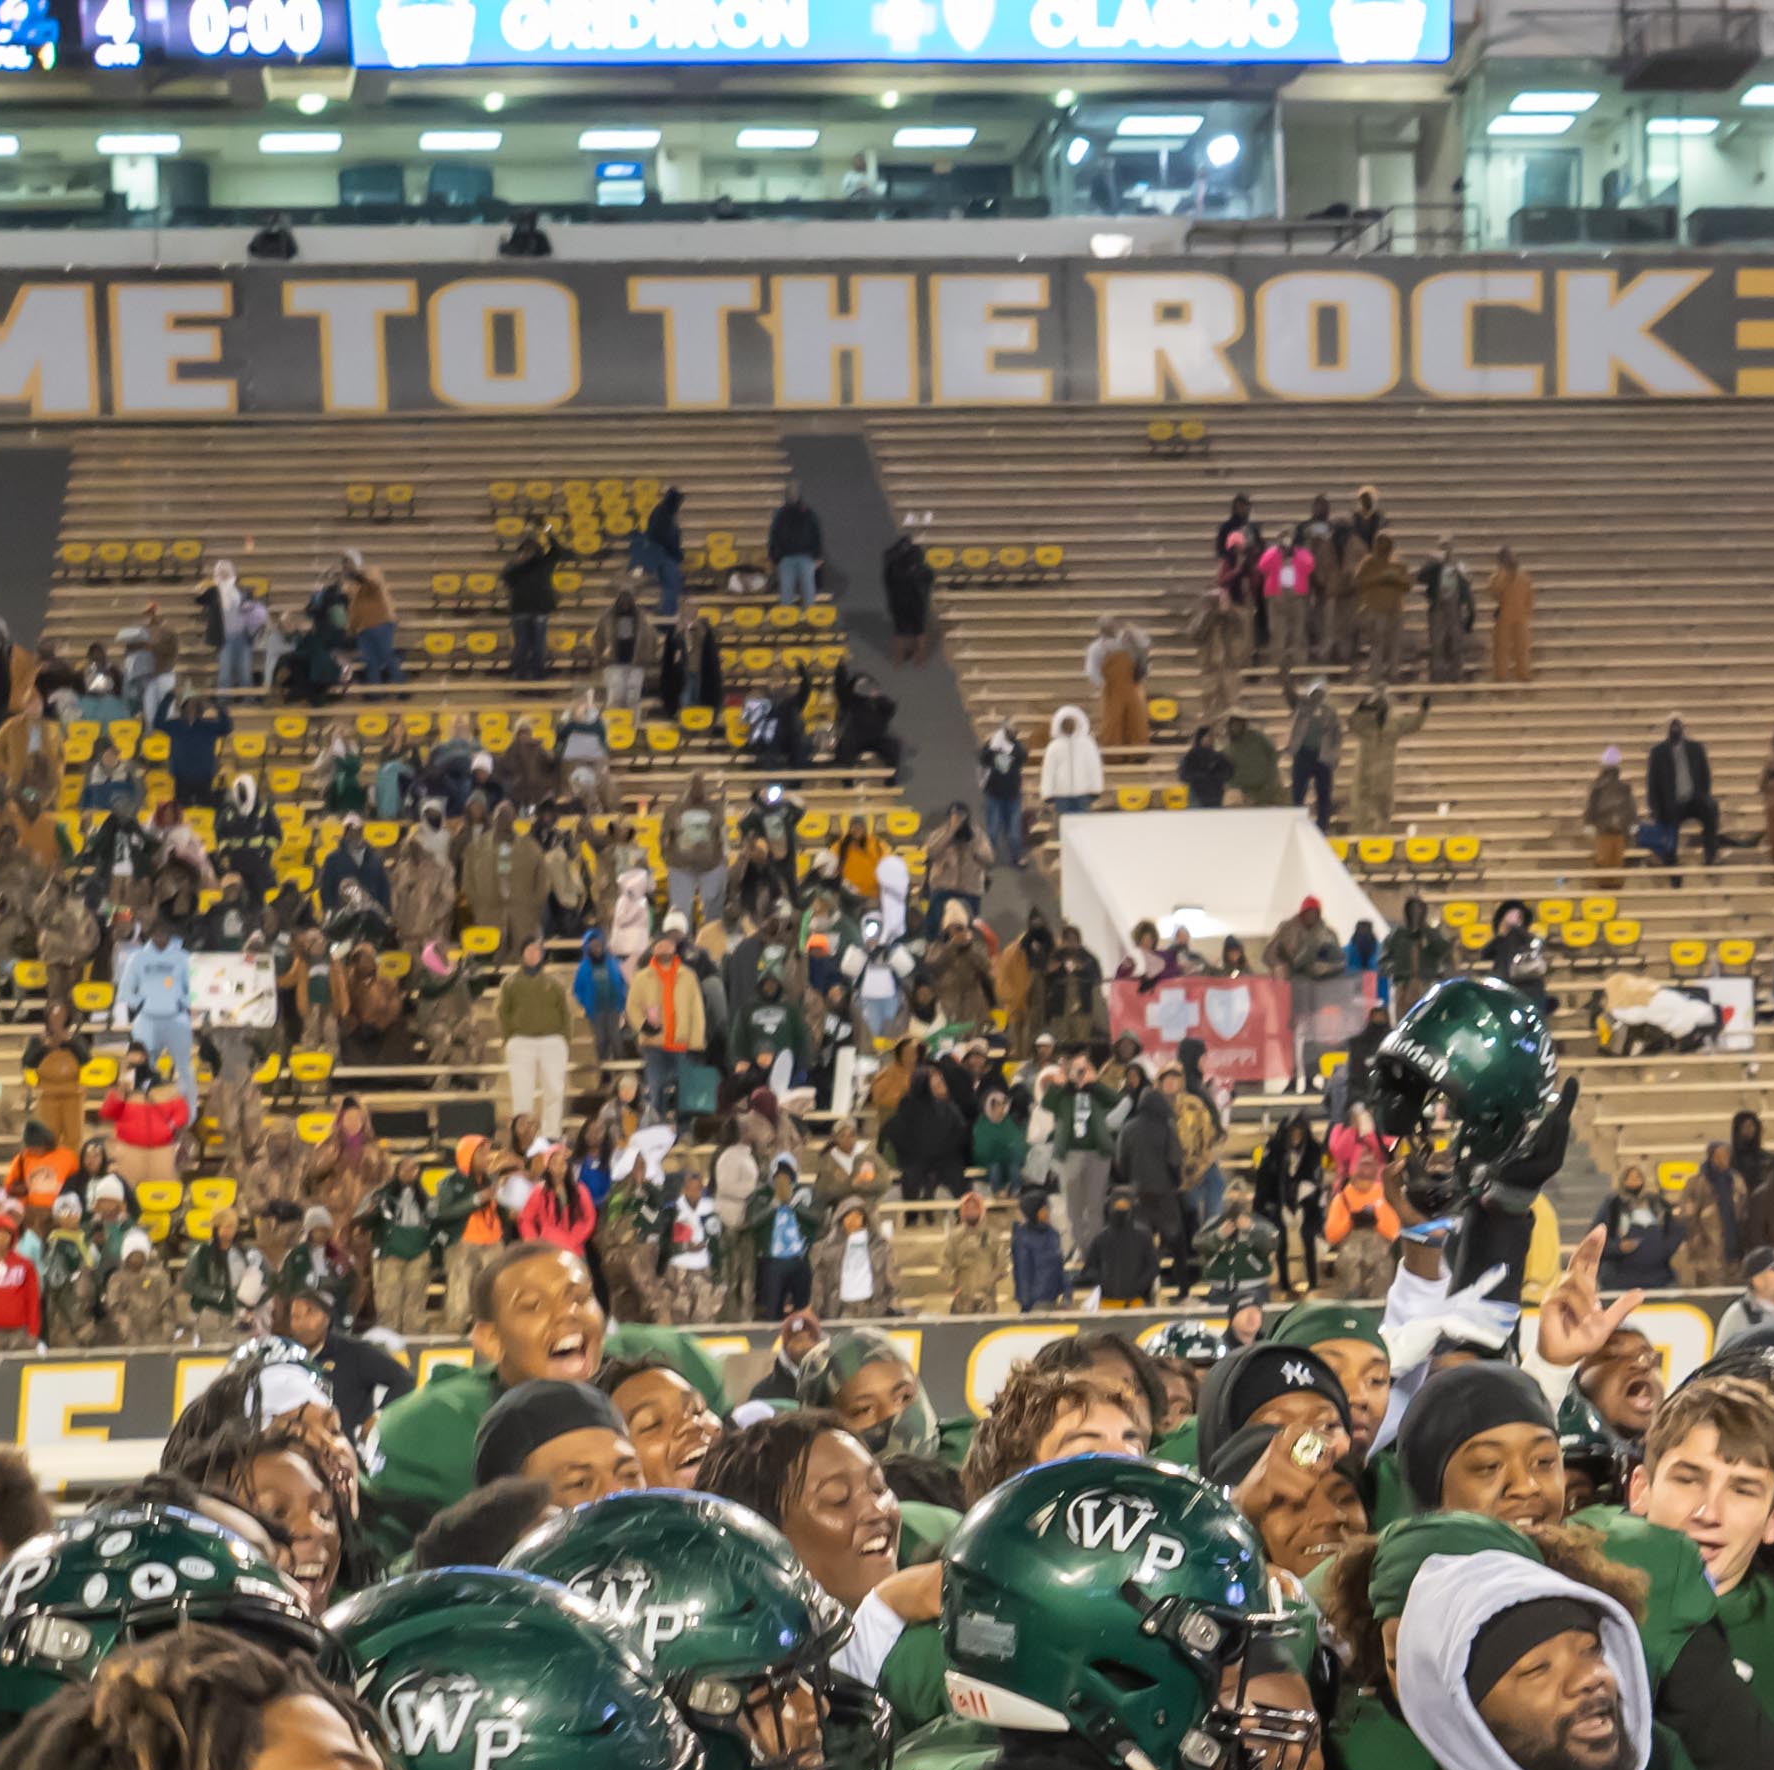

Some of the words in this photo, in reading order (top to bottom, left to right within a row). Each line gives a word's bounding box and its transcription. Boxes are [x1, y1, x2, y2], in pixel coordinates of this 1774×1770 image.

[94, 0, 137, 44] 4
[189, 0, 323, 55] 0:00
[282, 275, 581, 413] TO
[627, 270, 1055, 411] THE
[1086, 266, 1722, 406] ROCK
[1068, 1489, 1186, 1585] WP
